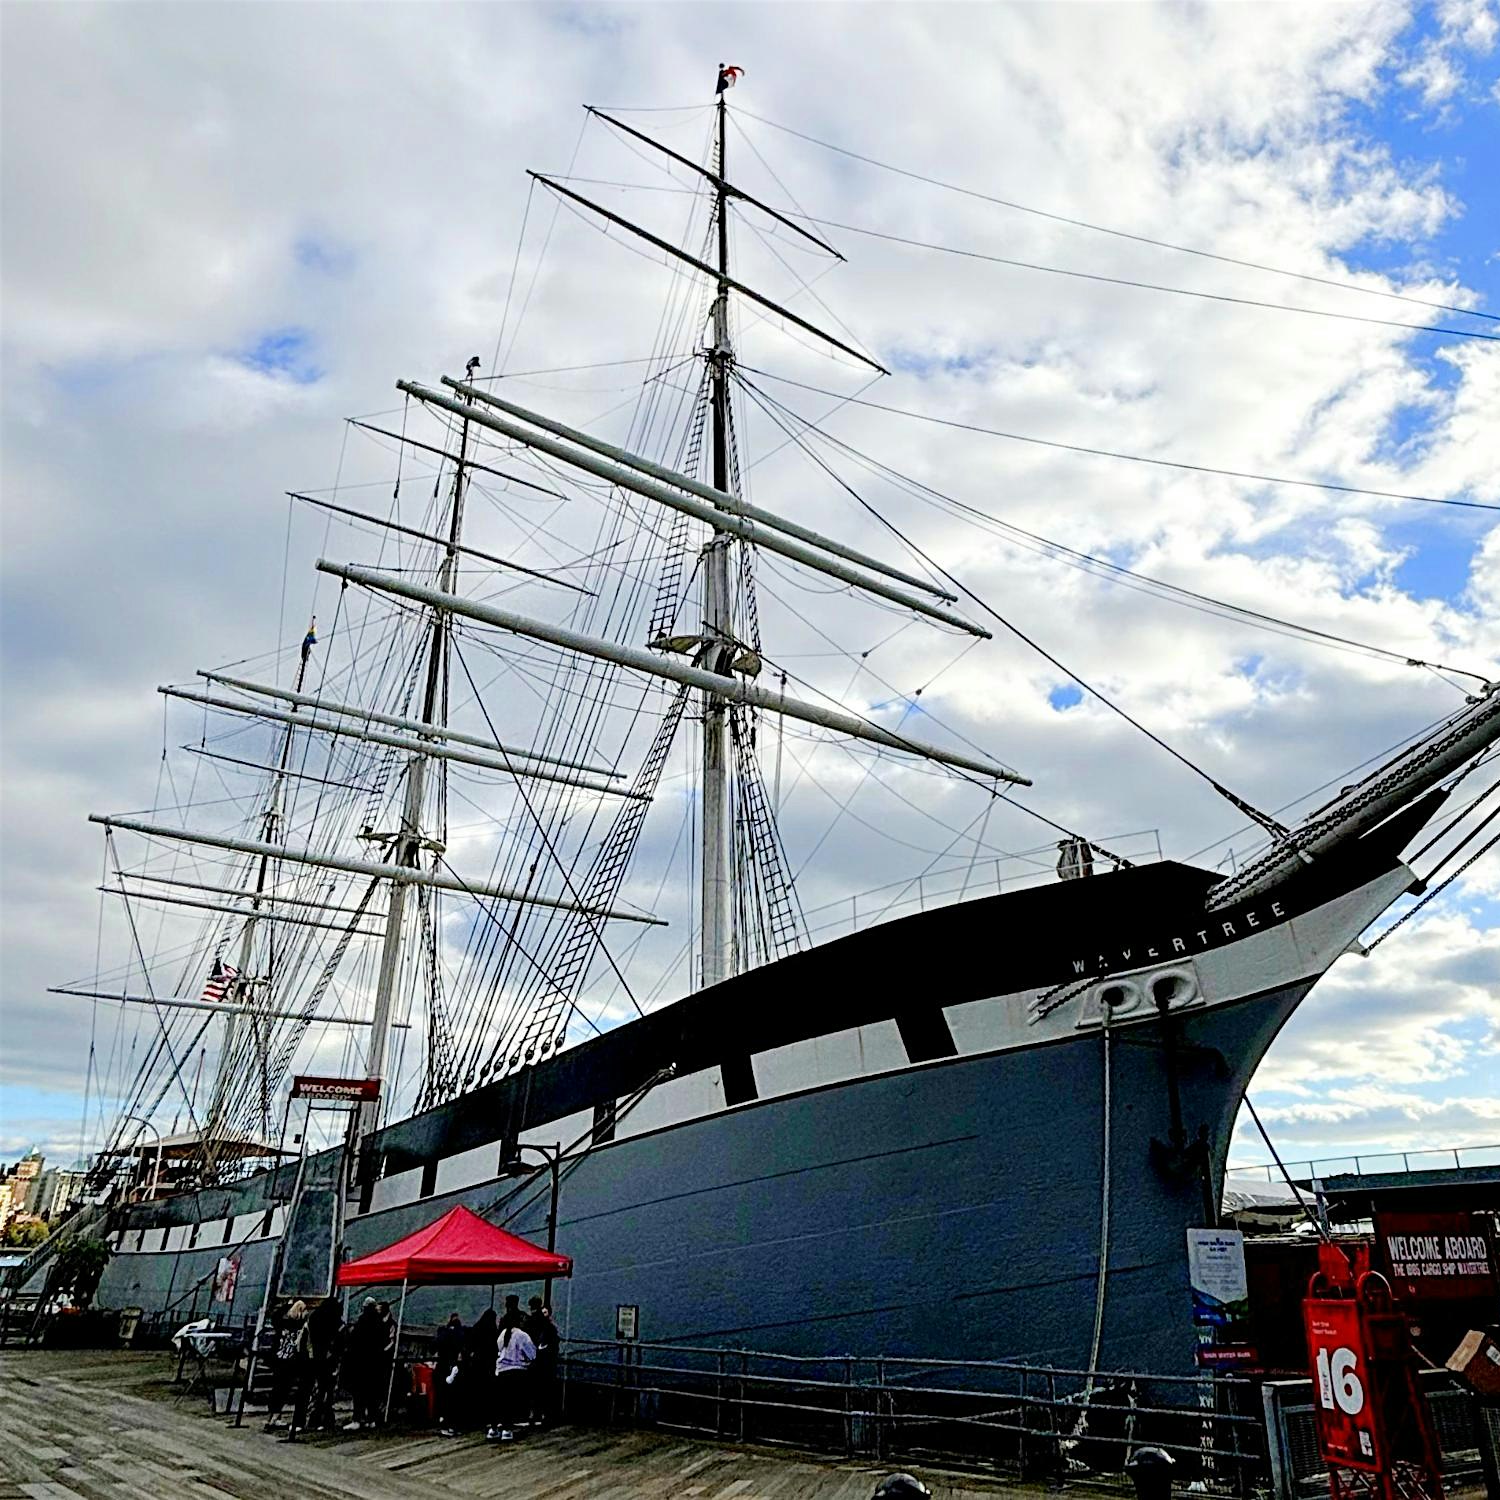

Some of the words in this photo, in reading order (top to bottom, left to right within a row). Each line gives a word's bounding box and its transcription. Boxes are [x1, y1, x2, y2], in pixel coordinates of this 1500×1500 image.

[299, 1083, 364, 1095] WELCOME
[1387, 1236, 1442, 1260] WELCOME
[1444, 1236, 1488, 1260] ABOARD
[1392, 1263, 1406, 1277] THE
[1421, 1263, 1442, 1276] CARGO
[1442, 1262, 1456, 1275] SHIP
[1316, 1347, 1364, 1415] 16
[1322, 1374, 1330, 1402] Pier
